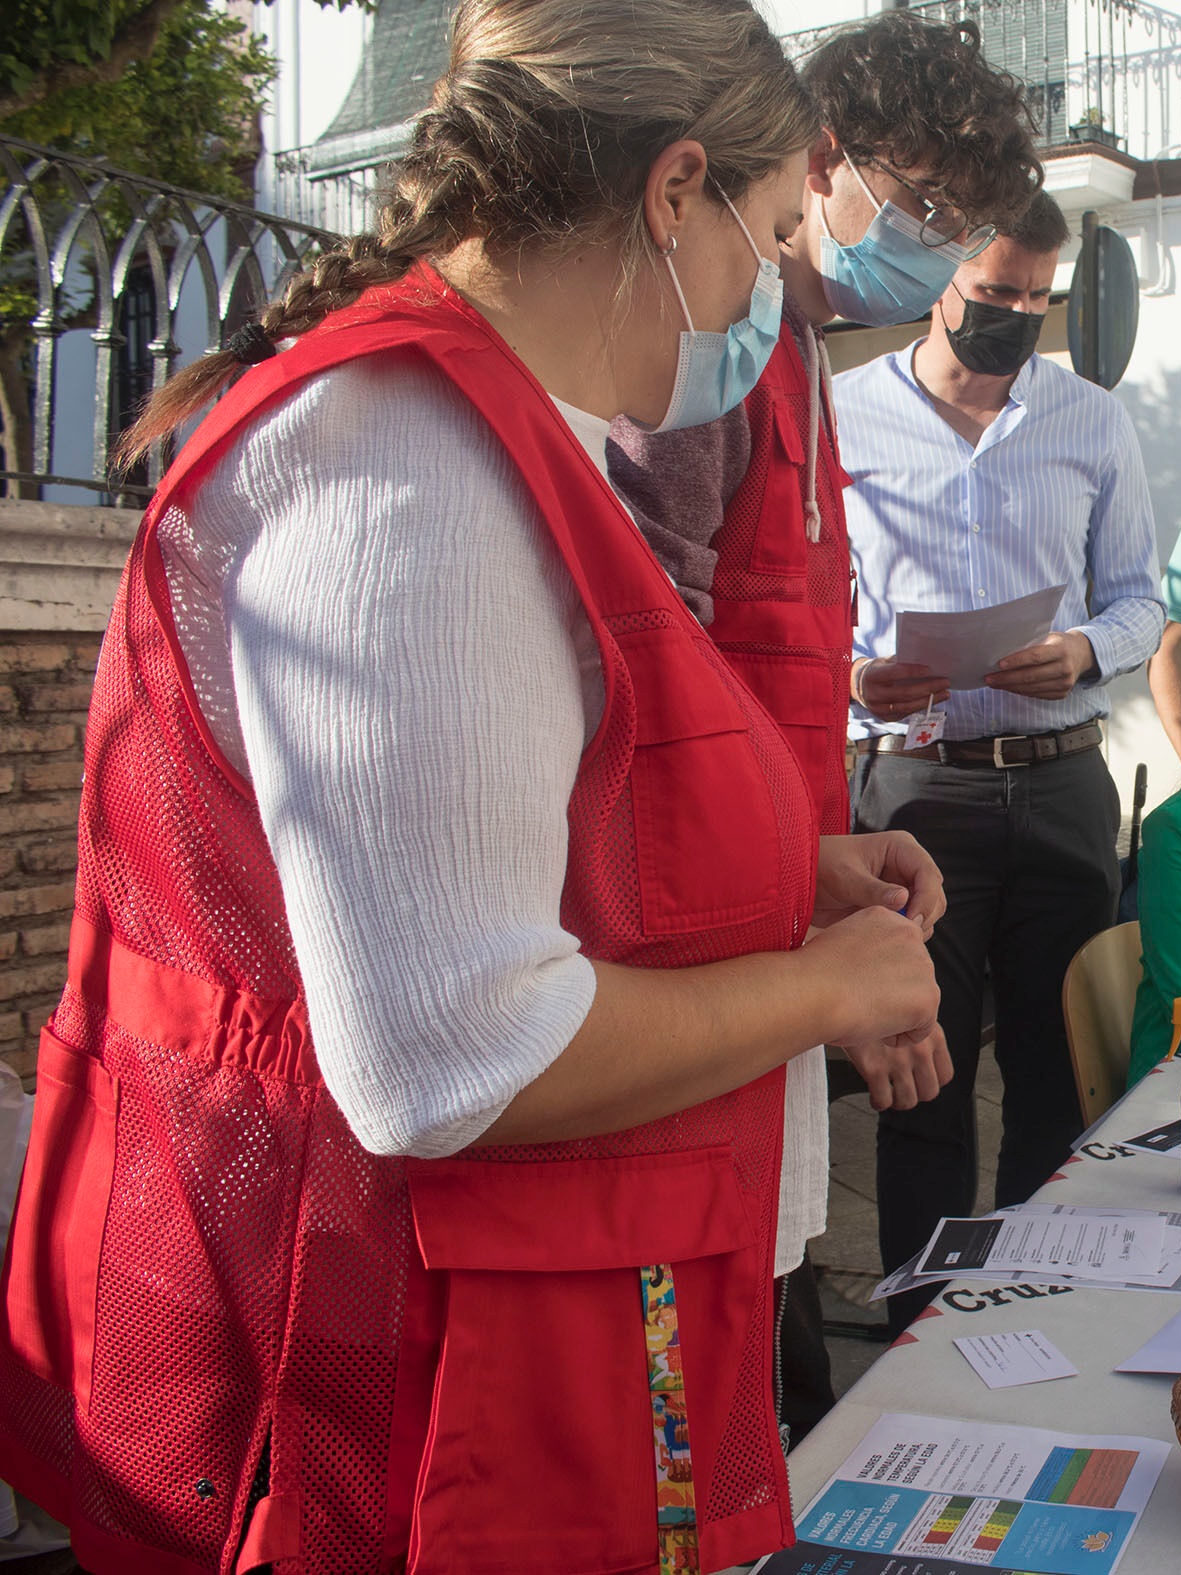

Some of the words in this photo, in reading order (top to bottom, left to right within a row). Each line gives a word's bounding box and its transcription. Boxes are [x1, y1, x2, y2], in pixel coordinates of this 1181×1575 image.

[1080, 1142, 1136, 1160] Cr
[856, 1454, 882, 1479] VALORES
[872, 1450, 902, 1480] NORMALES
[902, 1464, 922, 1484] SEGÚN
[924, 1443, 938, 1459] EDAD
[880, 1493, 900, 1514] SEGÚN
[808, 1511, 836, 1538] VALORES
[824, 1509, 856, 1542] NORMALES
[840, 1507, 874, 1544] FRECUENCIA
[872, 1540, 886, 1548] LA
[879, 1521, 898, 1539] EDAD
